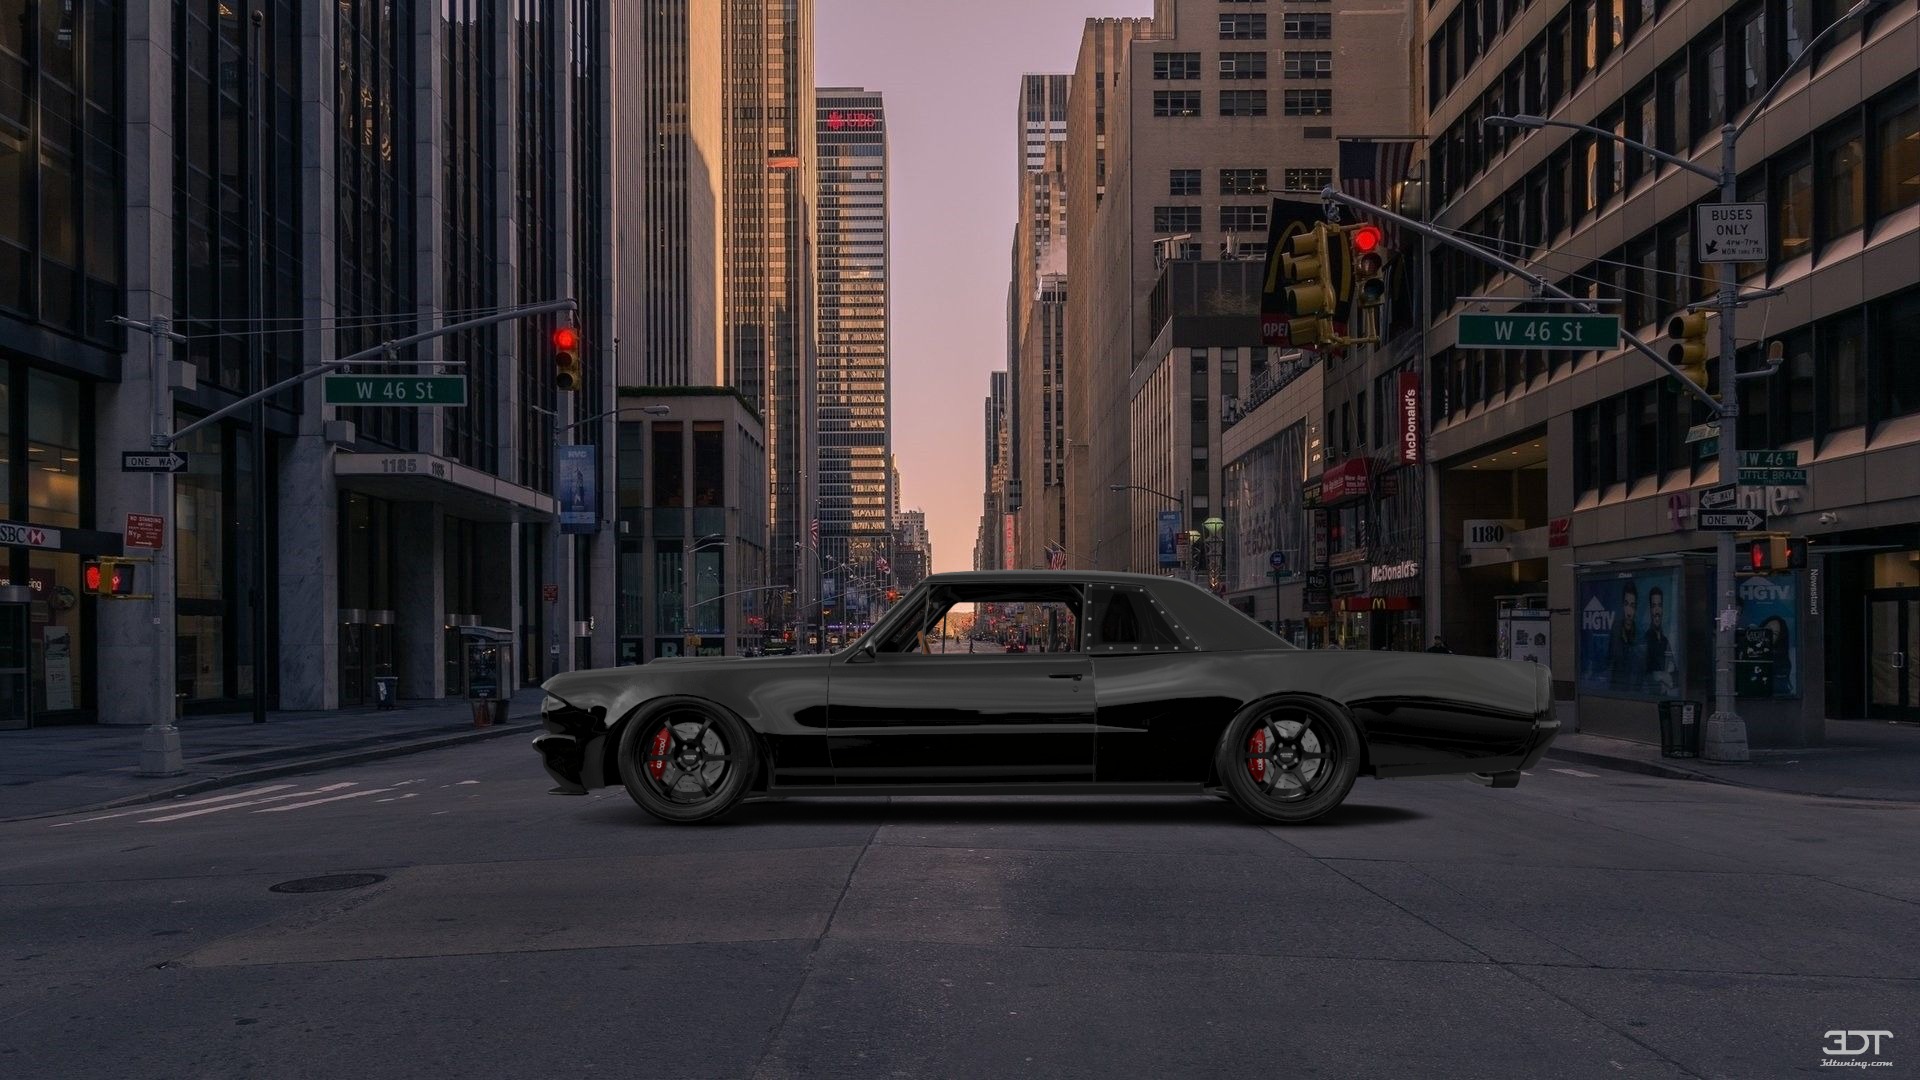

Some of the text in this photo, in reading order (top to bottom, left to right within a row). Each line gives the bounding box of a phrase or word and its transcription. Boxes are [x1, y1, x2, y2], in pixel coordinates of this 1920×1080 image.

[1711, 209, 1753, 221] BUSES
[1716, 224, 1748, 236] ONLY
[1721, 247, 1736, 255] MON
[1262, 322, 1288, 337] OPE
[1494, 321, 1582, 341] W 46 St
[356, 381, 434, 399] W 46 St
[1404, 389, 1416, 460] McDonald's
[130, 457, 178, 466] ONE WAY
[381, 459, 416, 472] 1185
[1749, 452, 1760, 466] W
[1765, 452, 1783, 466] 46
[1739, 470, 1804, 480] LITTLE BRAZIL
[1707, 516, 1755, 525] ONE WAY
[1471, 525, 1504, 543] 1180
[1371, 560, 1418, 583] McDonald's
[1740, 584, 1790, 601] HGTV
[1810, 568, 1819, 616] Newsstand
[1584, 610, 1616, 631] HGTV
